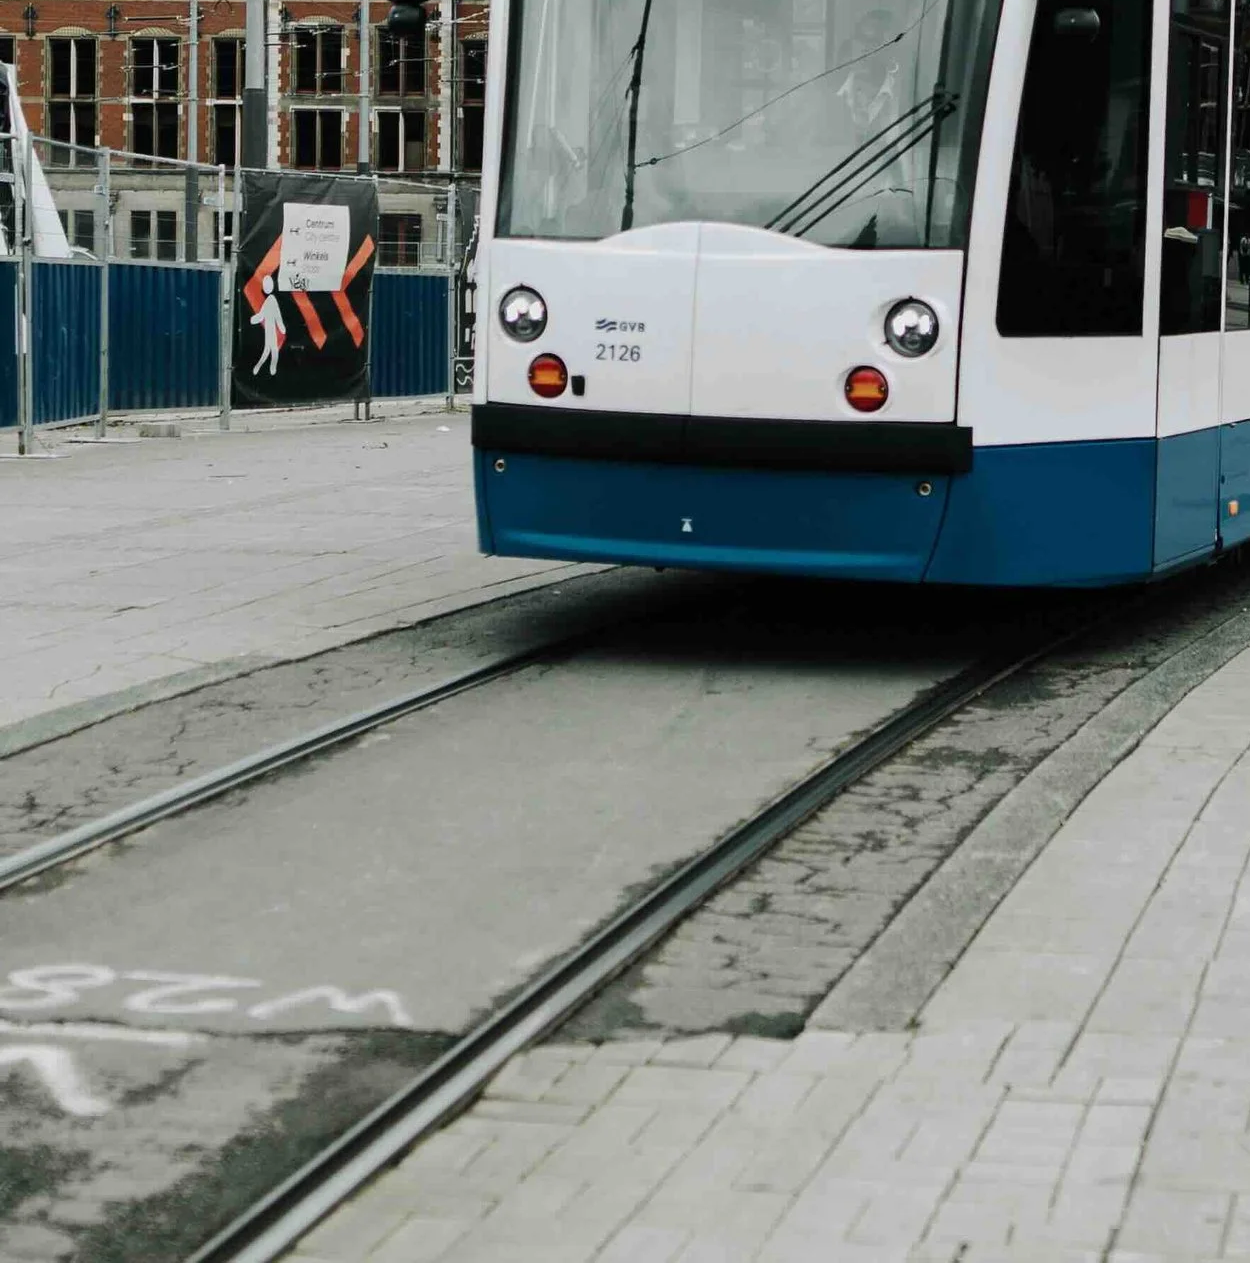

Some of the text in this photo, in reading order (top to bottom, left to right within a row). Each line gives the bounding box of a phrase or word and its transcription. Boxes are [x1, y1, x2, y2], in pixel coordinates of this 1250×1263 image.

[305, 219, 335, 229] Centrum
[303, 251, 329, 261] Winkels
[620, 321, 645, 332] GVB
[596, 344, 641, 362] 2126
